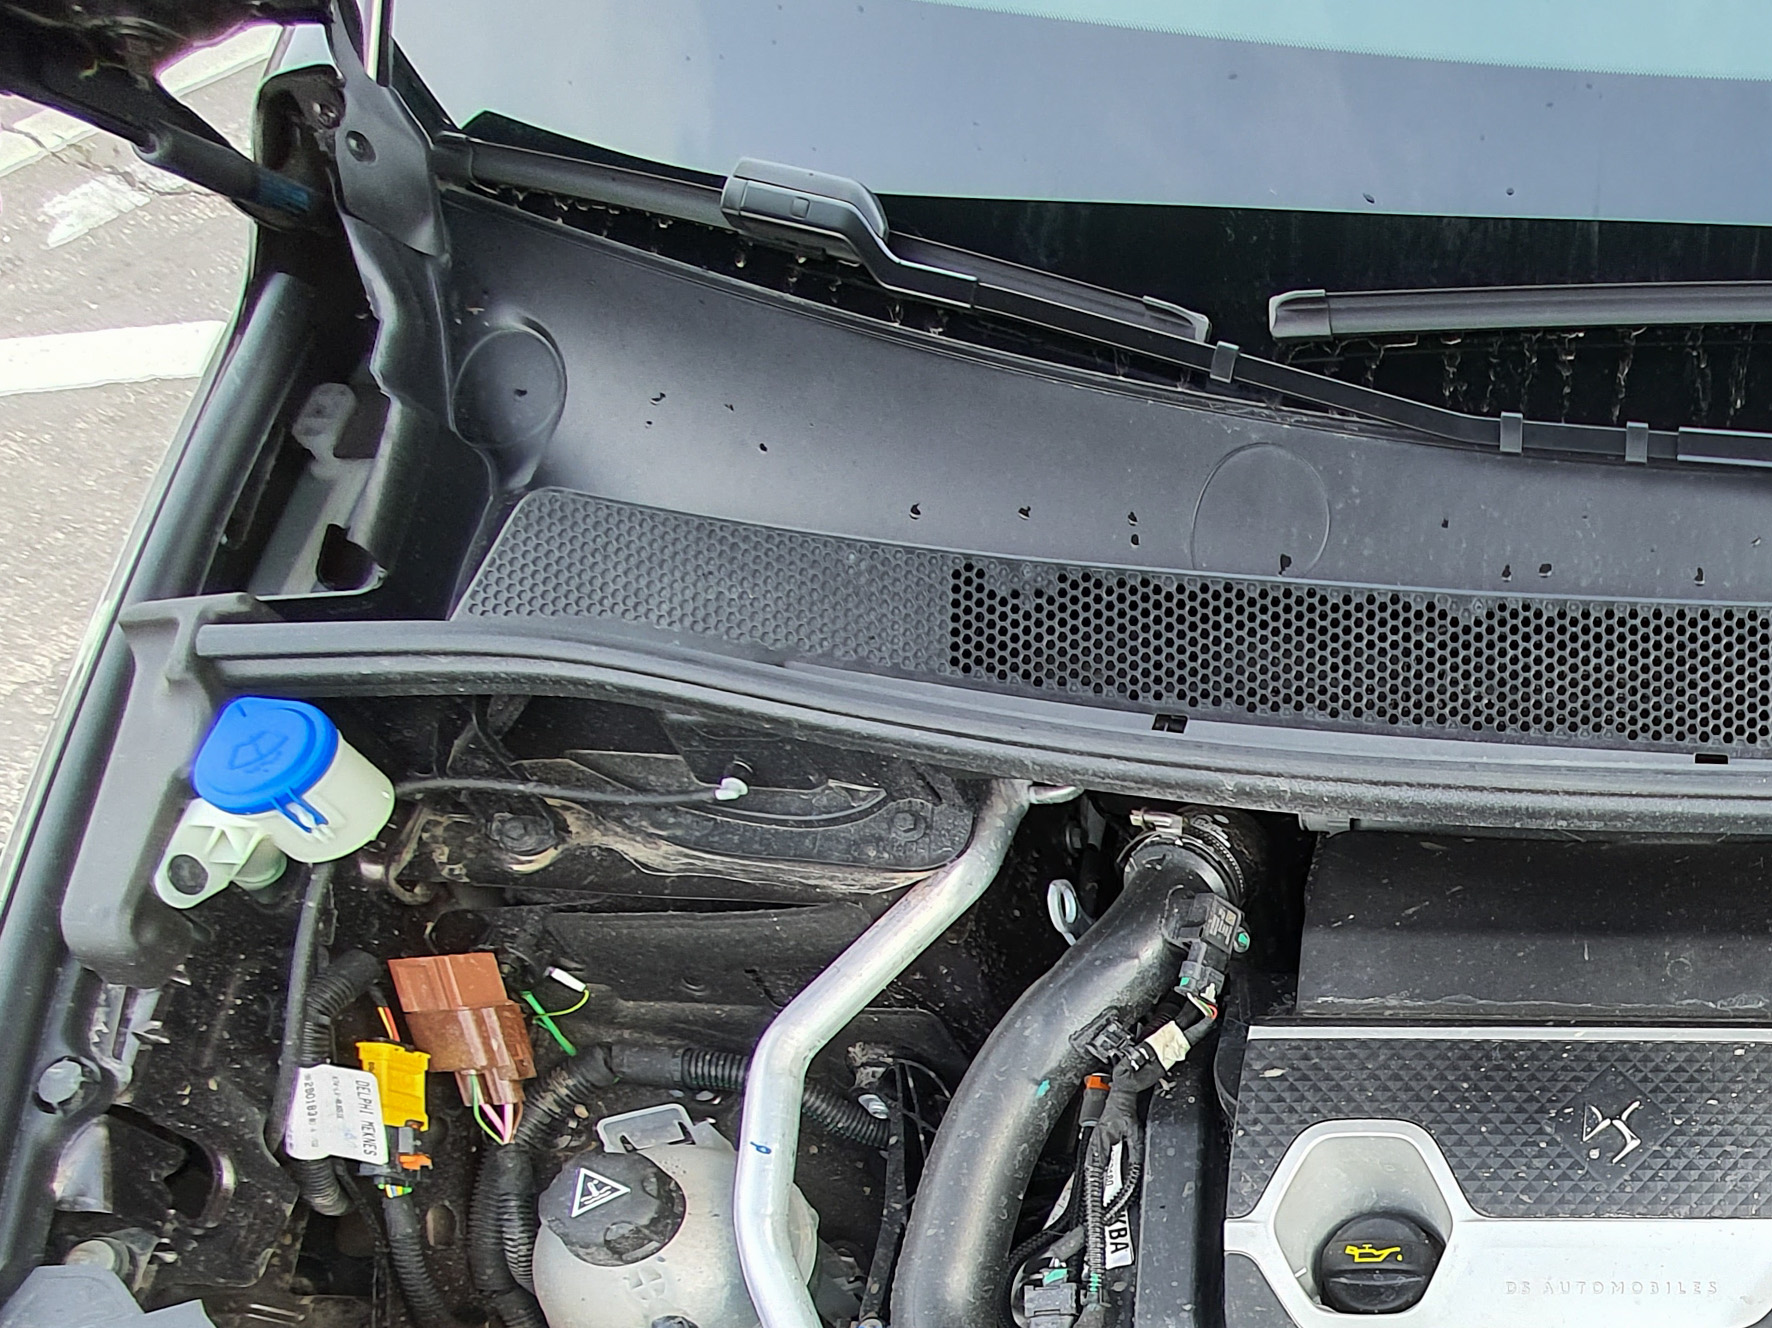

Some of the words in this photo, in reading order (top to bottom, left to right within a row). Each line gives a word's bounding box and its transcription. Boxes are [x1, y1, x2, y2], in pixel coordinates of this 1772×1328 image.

[356, 1080, 374, 1115] DELPHI
[361, 1120, 377, 1156] MEKNES
[1506, 1281, 1530, 1294] DS
[1543, 1281, 1718, 1295] AUTOMOBILES
